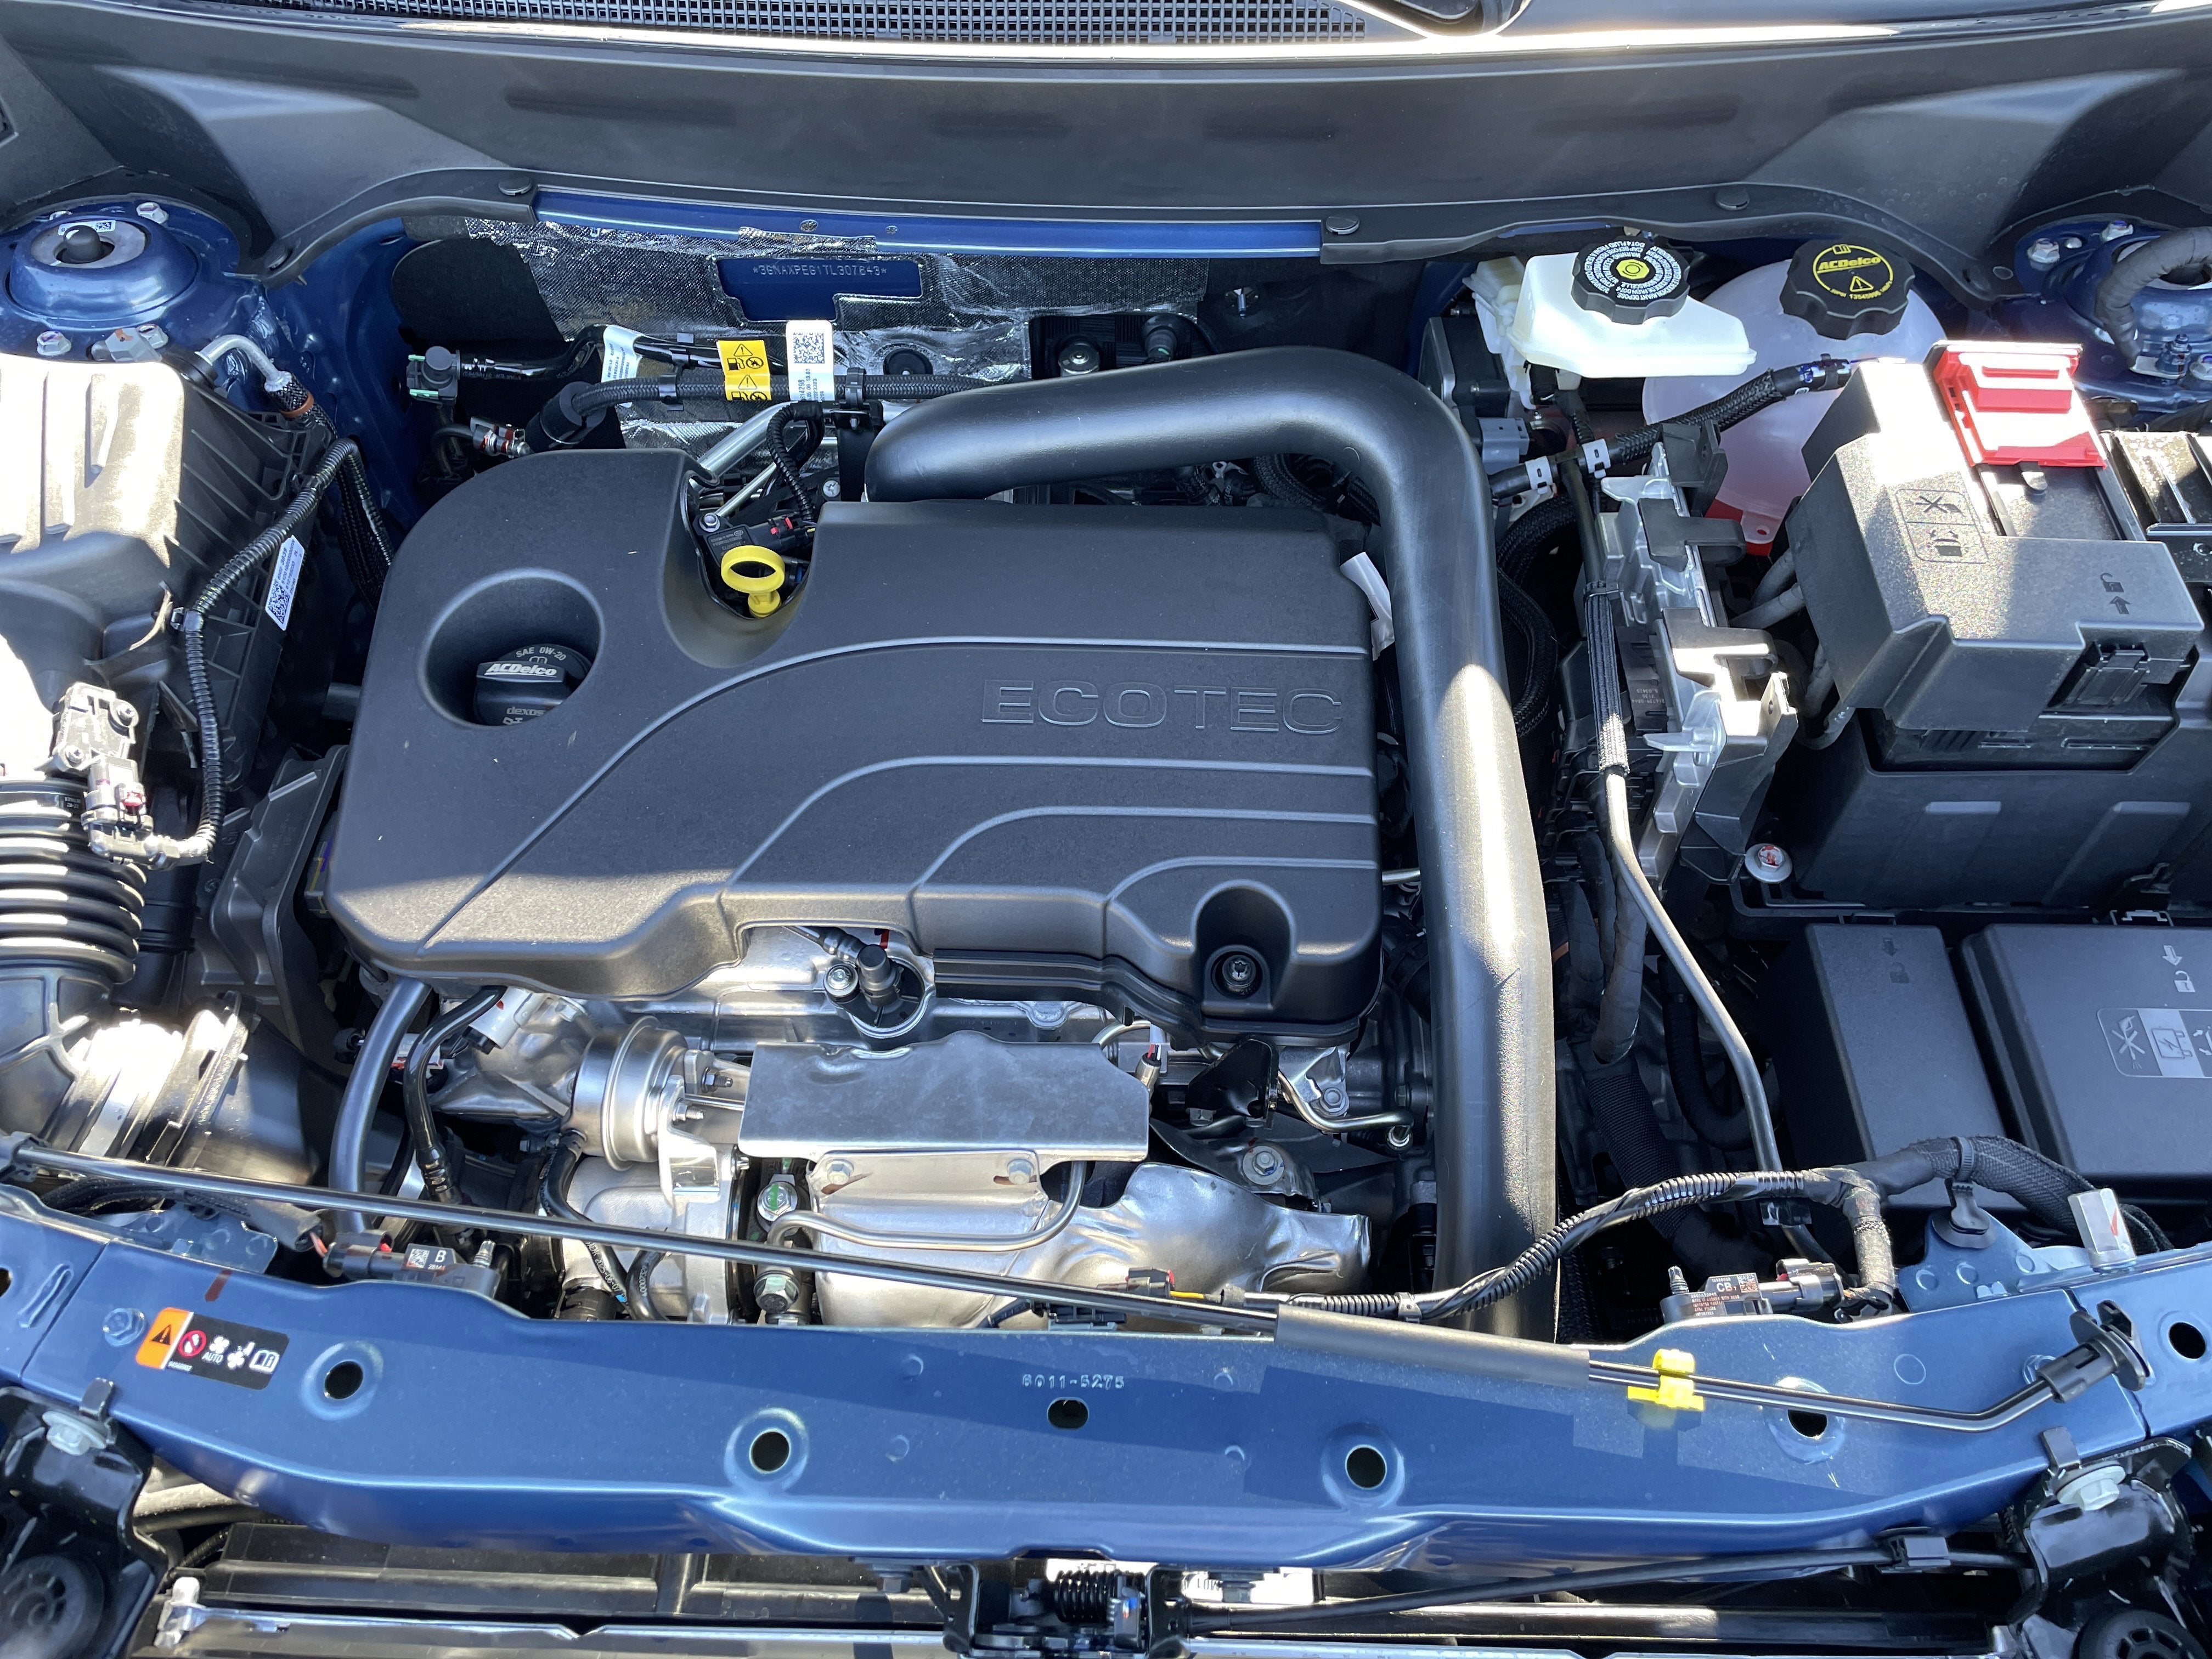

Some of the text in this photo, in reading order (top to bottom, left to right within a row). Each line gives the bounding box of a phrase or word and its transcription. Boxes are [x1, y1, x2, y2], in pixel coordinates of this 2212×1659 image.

[1818, 257, 1881, 270] ACDelco
[516, 646, 567, 661] SAE 0W-20
[486, 663, 557, 676] ACDelco
[506, 706, 546, 716] dexos
[981, 679, 1342, 735] ECOTEC
[435, 1250, 447, 1262] B
[1716, 1282, 1733, 1293] CB
[201, 1351, 224, 1365] AUTO
